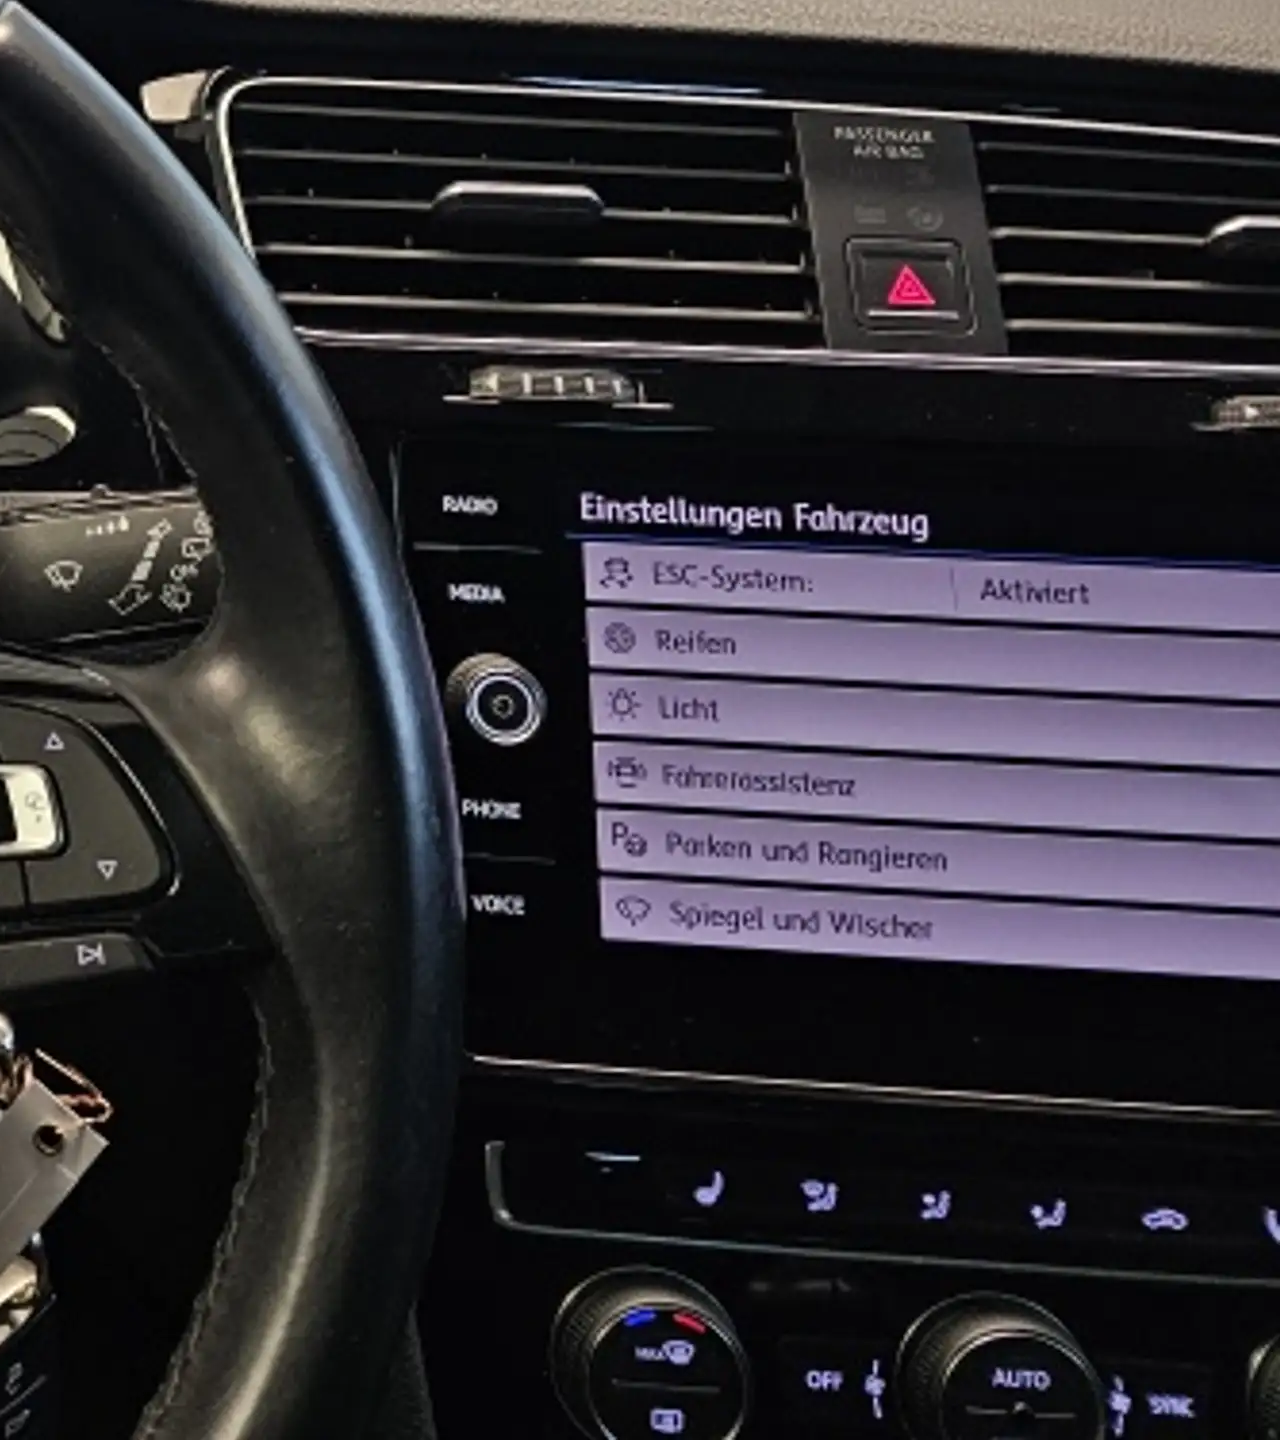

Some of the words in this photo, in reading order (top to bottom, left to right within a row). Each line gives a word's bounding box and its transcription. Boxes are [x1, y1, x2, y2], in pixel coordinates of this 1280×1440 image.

[442, 494, 499, 516] RADIO
[579, 491, 782, 535] Einstellungen
[794, 502, 930, 543] Fahrzeug
[447, 583, 506, 604] MEDIA
[652, 562, 814, 593] ESC-System:
[979, 578, 1090, 606] Aktiviert
[654, 628, 737, 656] Reifen
[657, 695, 721, 723] Licht
[661, 762, 857, 798] Fahrerassistenz
[461, 797, 523, 821] PHONE
[665, 829, 753, 862] Parken
[761, 839, 810, 865] und
[818, 839, 949, 874] Rangieren
[469, 893, 527, 916] VOICE
[668, 899, 765, 935] Spiegel
[773, 909, 821, 935] und
[827, 908, 934, 940] Wischer
[804, 1369, 844, 1391] OFF
[991, 1367, 1051, 1390] AUTO
